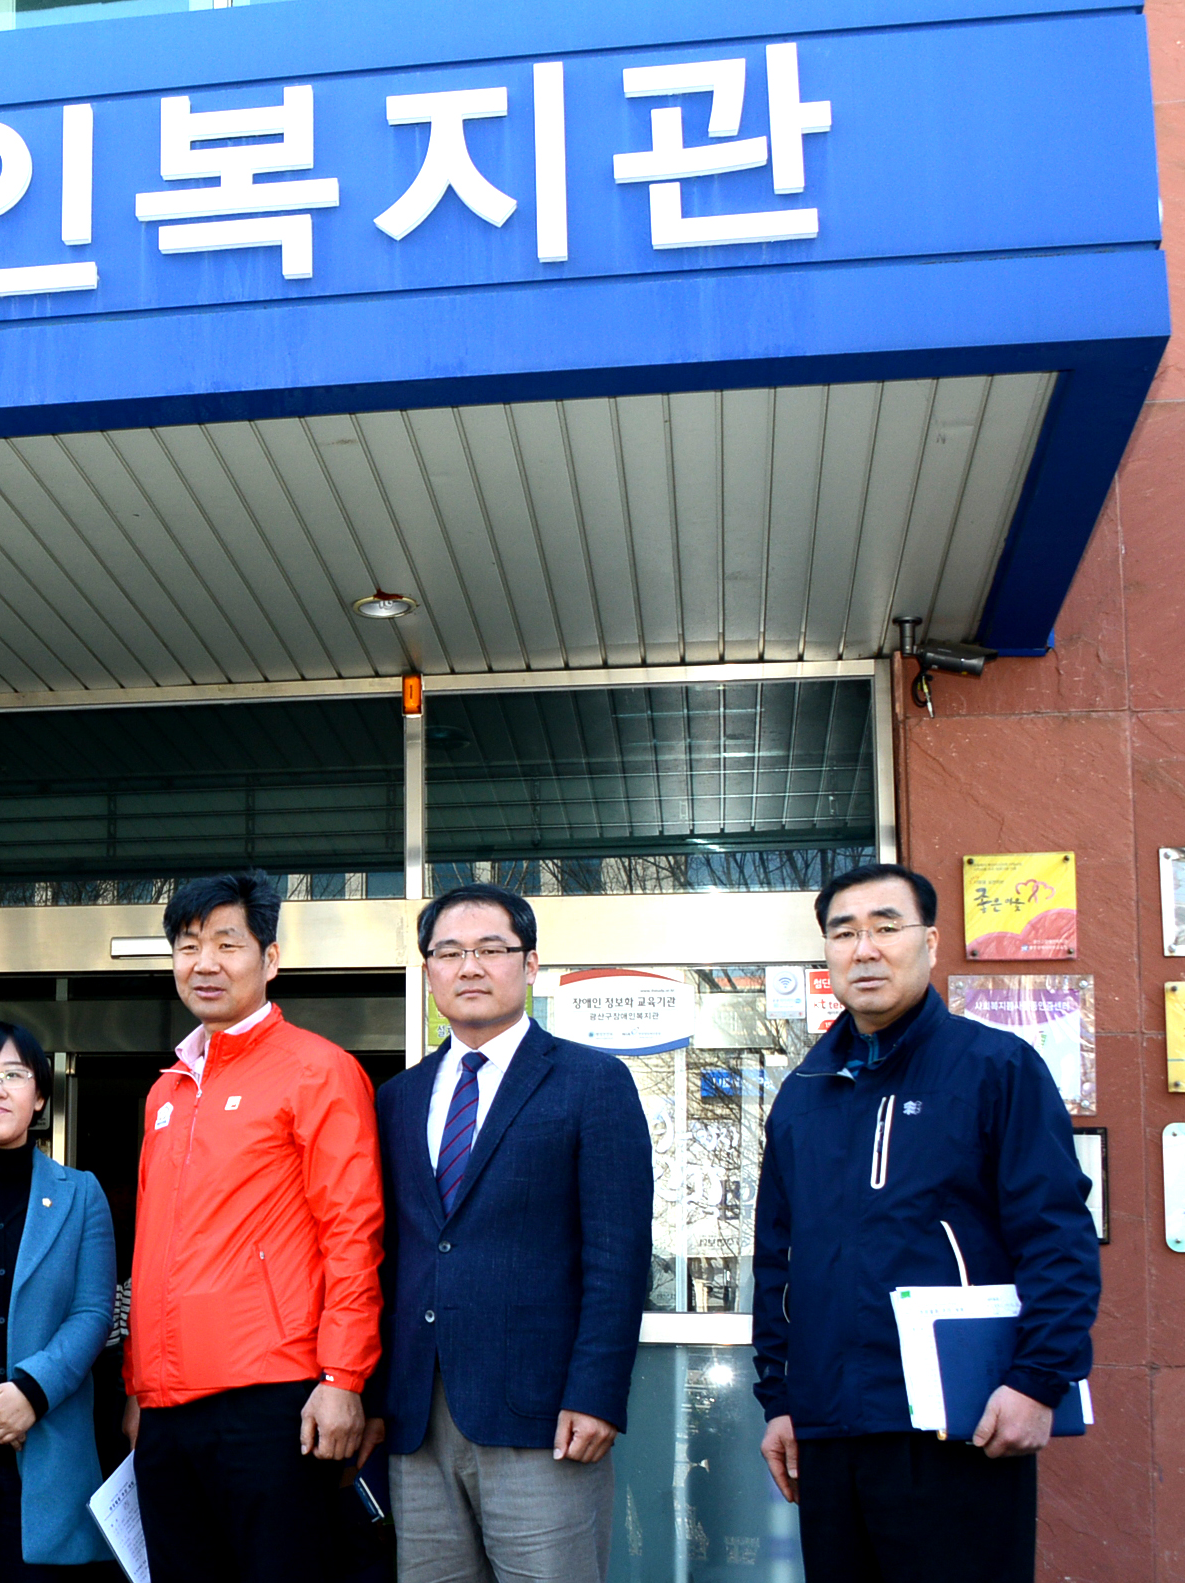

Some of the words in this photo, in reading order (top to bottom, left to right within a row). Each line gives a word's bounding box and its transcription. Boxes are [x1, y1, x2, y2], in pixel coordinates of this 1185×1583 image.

[573, 997, 601, 1009] 장애인
[605, 997, 634, 1009] 정보화
[637, 996, 675, 1008] 교육기관
[589, 1012, 660, 1020] 광산구장애인복지관
